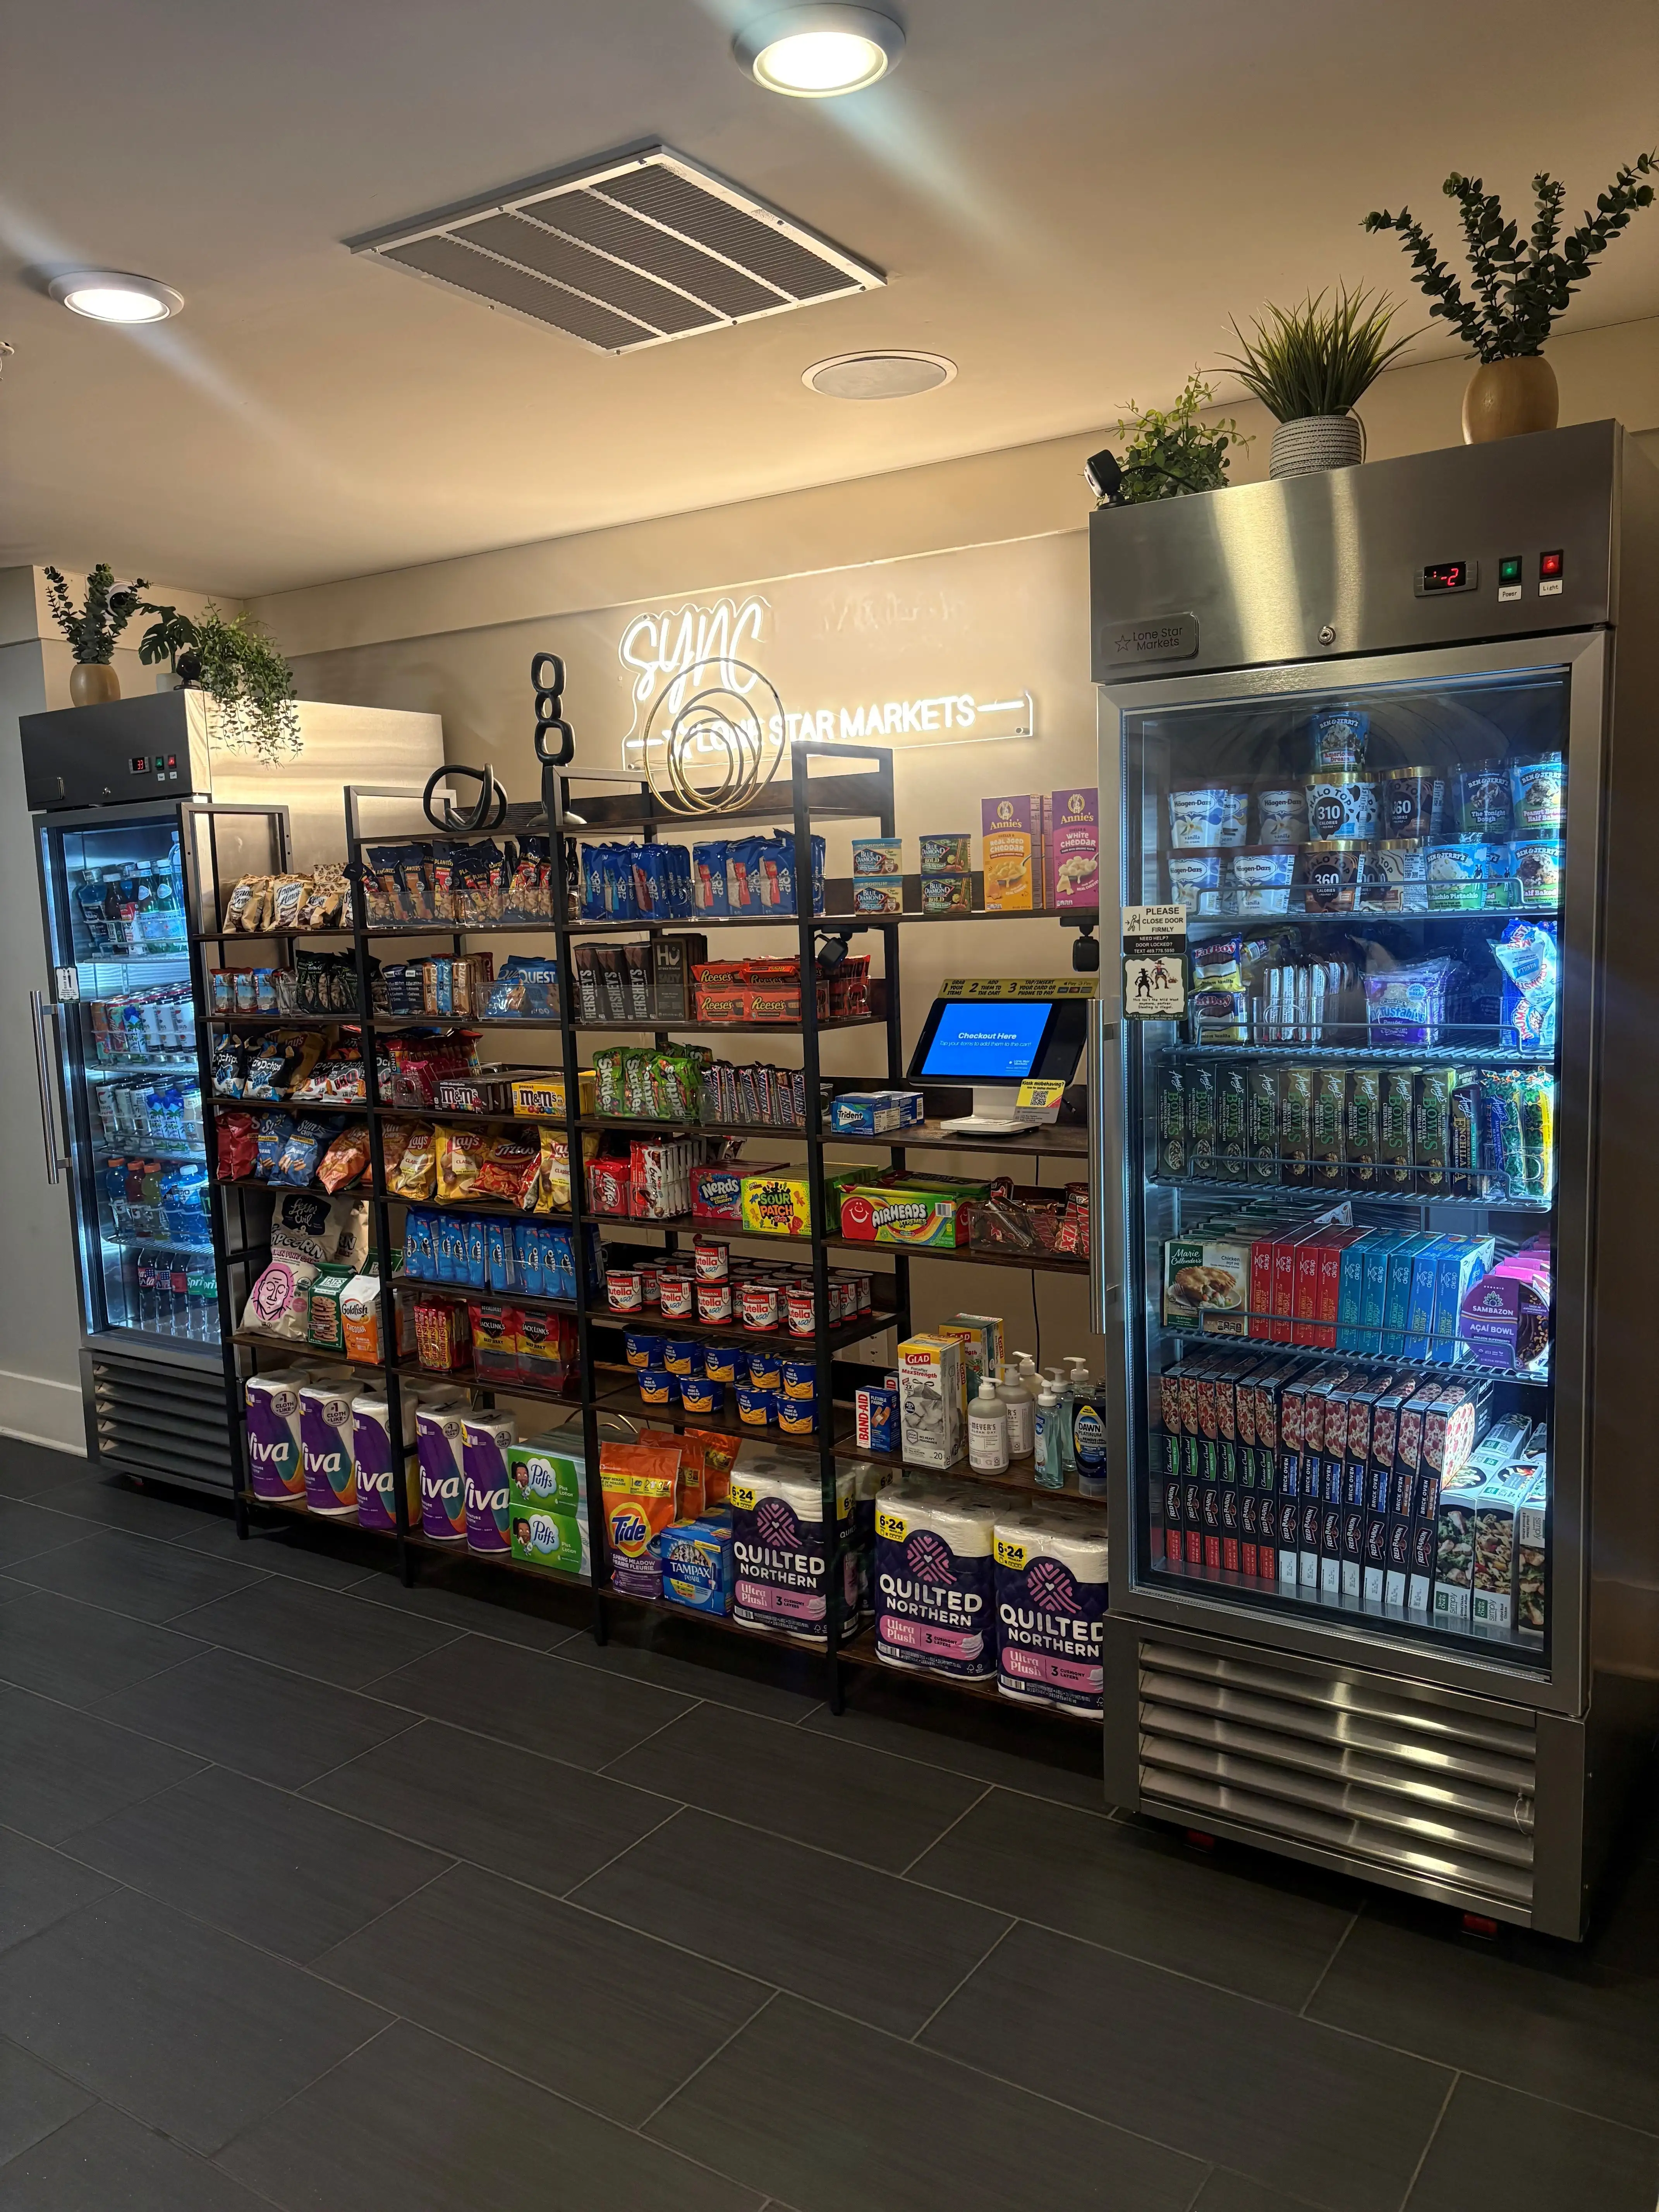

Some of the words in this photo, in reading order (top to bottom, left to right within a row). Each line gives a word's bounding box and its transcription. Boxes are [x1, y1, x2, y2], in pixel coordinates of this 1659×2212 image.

[1133, 631, 1158, 641] Lone
[1162, 627, 1182, 637] Star
[1137, 638, 1179, 651] Markets
[769, 713, 835, 745] STAR
[840, 694, 975, 737] MARKETS
[1174, 799, 1211, 808] Häagen-Dazs
[1310, 788, 1330, 808] HALO
[1334, 789, 1351, 807] TOP
[1061, 812, 1094, 824] Annie's
[1318, 806, 1340, 820] 310
[990, 819, 1022, 830] Annie's
[517, 969, 555, 984] QUEST
[943, 983, 948, 992] 1
[969, 983, 977, 993] 2
[1008, 983, 1017, 993] 3
[580, 970, 596, 1019] HERSHEY'S
[838, 1110, 862, 1119] Trident
[409, 1135, 428, 1150] Lay's
[452, 1135, 480, 1151] Lay's
[759, 1192, 791, 1204] SOUR
[759, 1205, 794, 1216] PATCH
[872, 1203, 927, 1228] AIRHEADS
[900, 1218, 927, 1226] XTREMES
[1172, 1249, 1200, 1258] Marie
[342, 1304, 368, 1316] Goldfish
[1473, 1306, 1513, 1316] SAMBAZON
[347, 1324, 366, 1333] CHEDDAR
[1470, 1324, 1489, 1332] AÇAÍ
[1491, 1326, 1514, 1335] BOWL
[907, 1355, 929, 1364] GLAD
[902, 1369, 937, 1379] MaxStrength
[859, 1393, 869, 1441] BAND-AID
[1079, 1422, 1101, 1432] DAWN
[934, 1452, 942, 1460] 20
[531, 1464, 552, 1489] Puffs
[533, 1520, 555, 1545] Puffs
[612, 1516, 646, 1545] Tide
[613, 1554, 628, 1562] SPRING
[613, 1559, 629, 1568] PRAIRIE
[734, 1541, 824, 1575] QUILTED
[670, 1562, 711, 1578] TAMPAX
[740, 1565, 817, 1589] NORTHERN
[879, 1574, 982, 1613] QUILTED
[886, 1597, 972, 1626] NORTHERN
[887, 1618, 915, 1634] Ultra
[887, 1630, 916, 1645] Plush
[925, 1633, 933, 1644] 3
[934, 1636, 958, 1645] CUSHIONY
[1008, 1628, 1099, 1657] NORTHERN
[1010, 1650, 1039, 1667] Ultra
[1010, 1661, 1042, 1677] Plush
